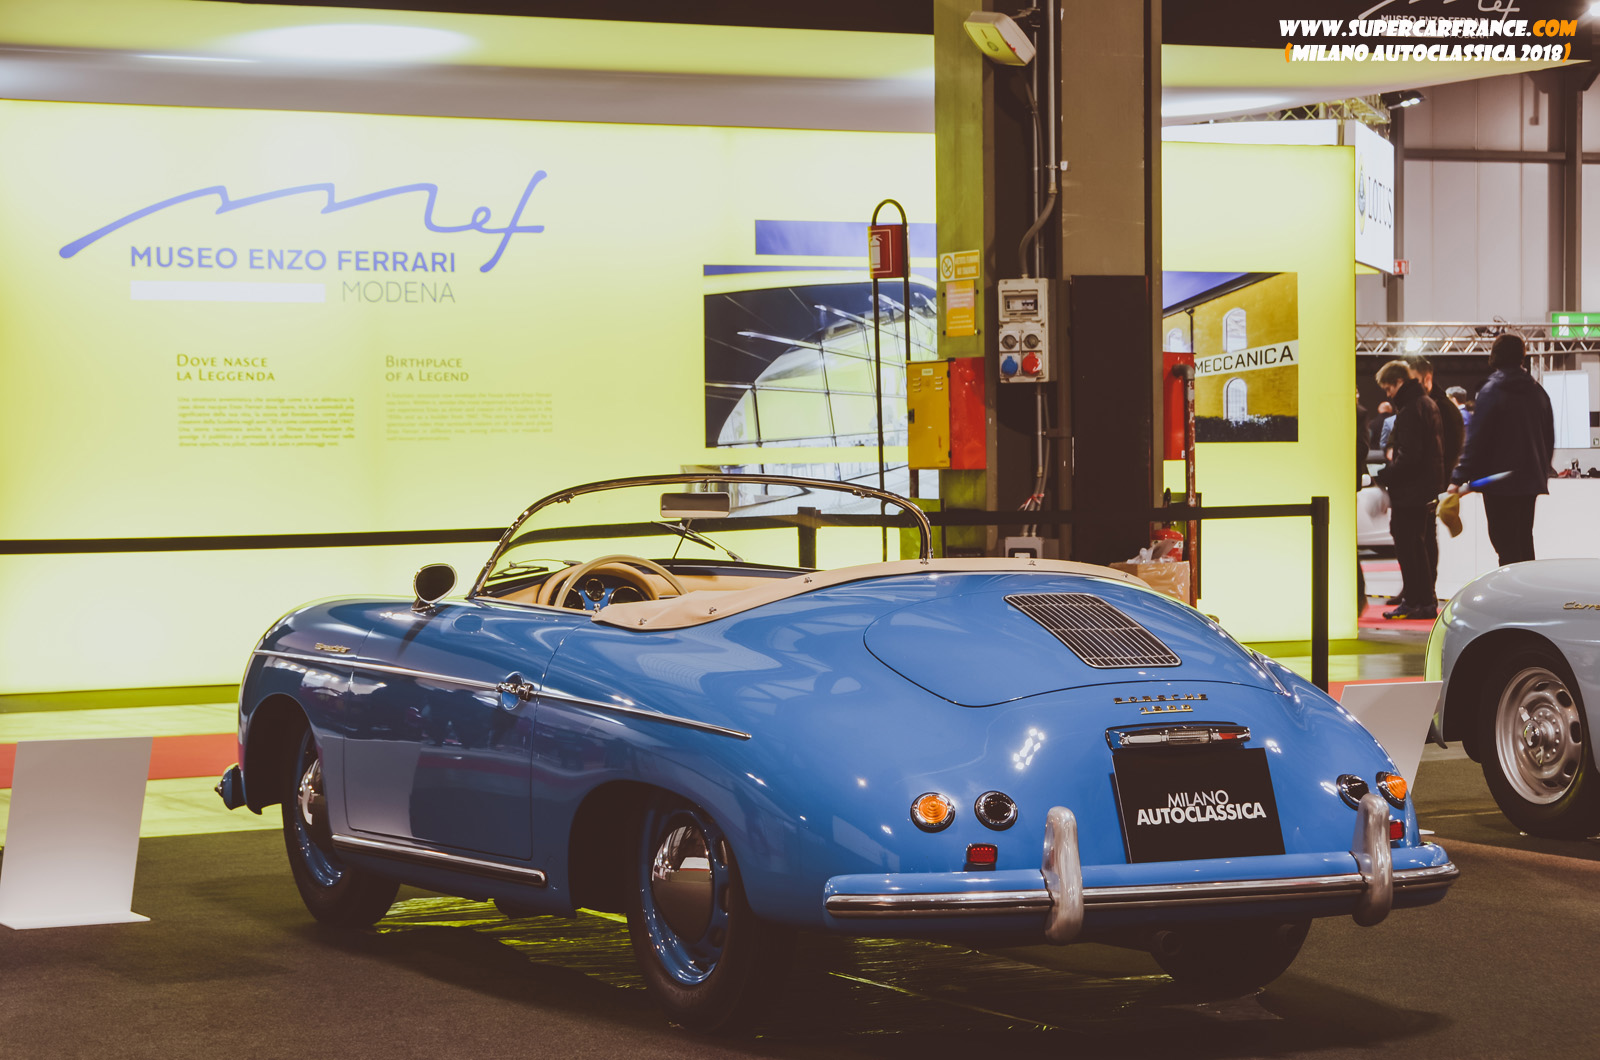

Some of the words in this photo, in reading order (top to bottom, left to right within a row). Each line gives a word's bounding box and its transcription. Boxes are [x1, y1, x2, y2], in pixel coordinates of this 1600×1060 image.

[1368, 176, 1393, 229] LOTUS
[131, 246, 238, 269] MUSEO
[249, 248, 327, 271] ENZO
[338, 250, 456, 273] FERRARI
[342, 280, 456, 304] MODENA
[1194, 345, 1294, 374] MECCANICA
[1113, 693, 1209, 704] PORSCHE
[1167, 789, 1230, 809] MILANO
[1136, 802, 1267, 826] AUTOCLASSICA
